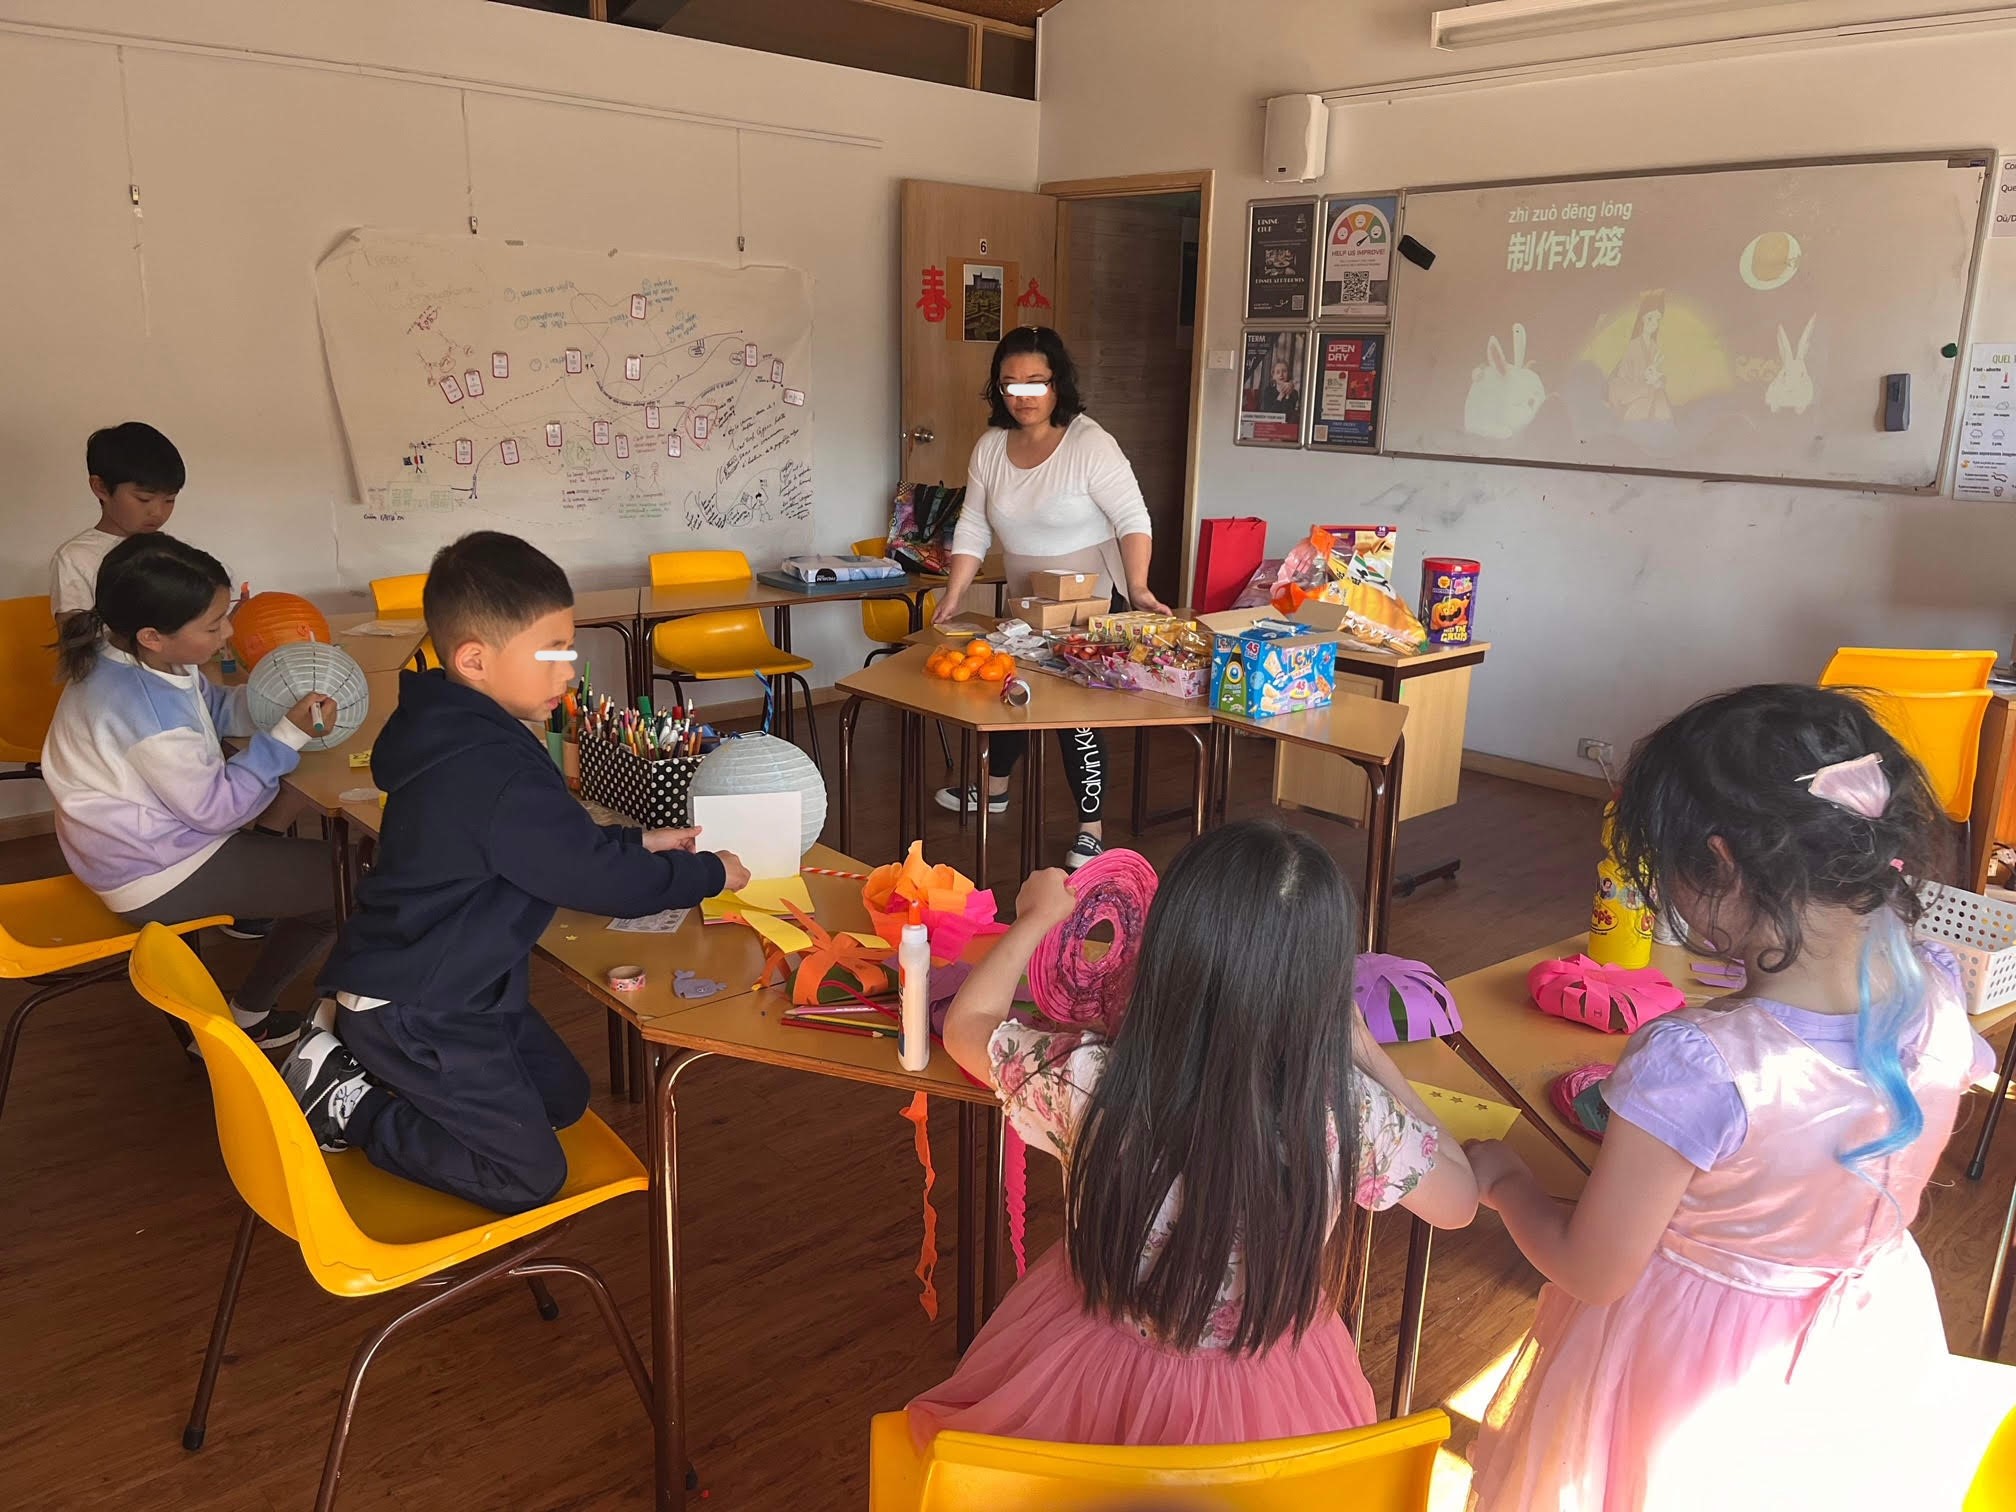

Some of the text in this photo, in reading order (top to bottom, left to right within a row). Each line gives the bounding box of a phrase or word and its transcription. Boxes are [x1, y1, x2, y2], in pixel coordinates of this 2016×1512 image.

[980, 240, 987, 253] 6
[1506, 226, 1625, 273] 制作灯笼
[1357, 248, 1386, 257] IMPROVE!
[916, 264, 953, 323] 春
[1248, 335, 1266, 343] TERM
[1328, 344, 1356, 353] OPEN
[1328, 353, 1349, 361] DAY
[1246, 641, 1260, 654] 45
[1296, 680, 1306, 690] 45
[1081, 750, 1102, 813] Calvin
